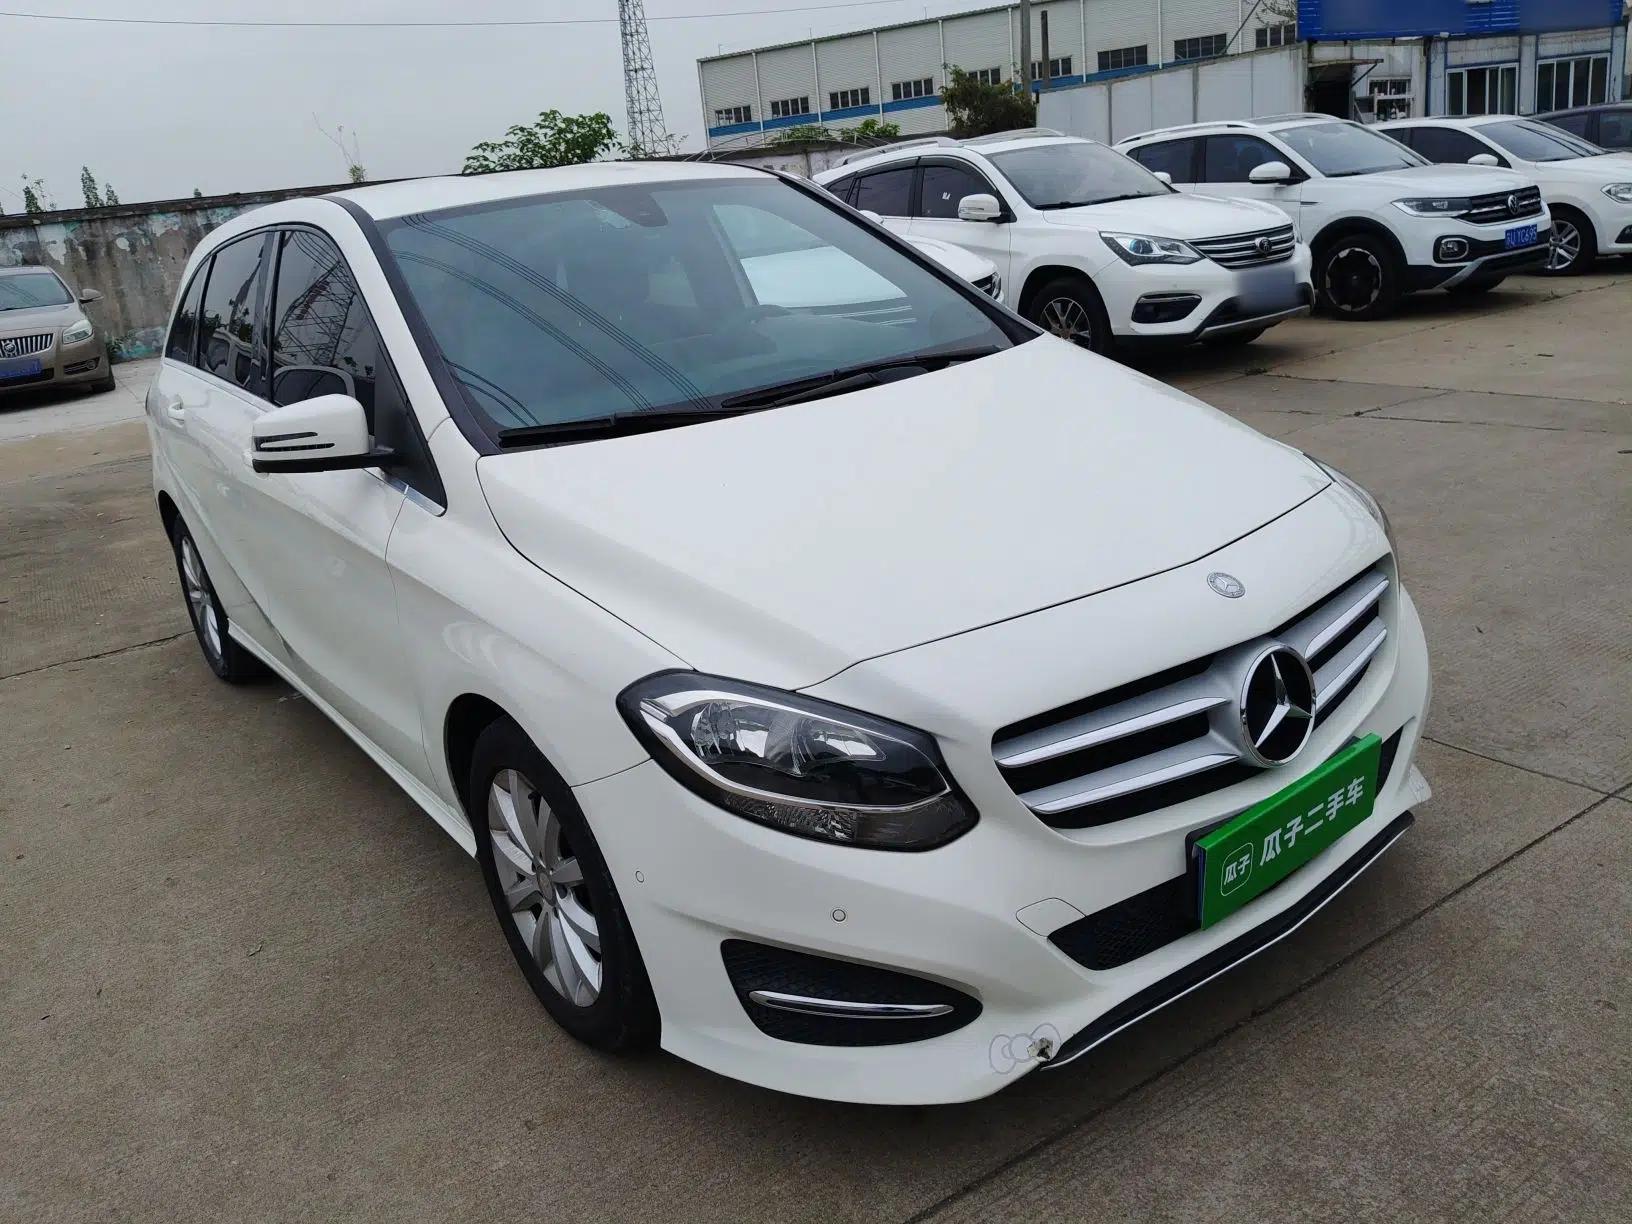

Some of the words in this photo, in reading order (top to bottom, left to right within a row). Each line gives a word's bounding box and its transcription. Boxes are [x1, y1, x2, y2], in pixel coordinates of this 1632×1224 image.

[1259, 775, 1365, 867] 瓜子二手车
[1223, 853, 1250, 886] 瓜子
